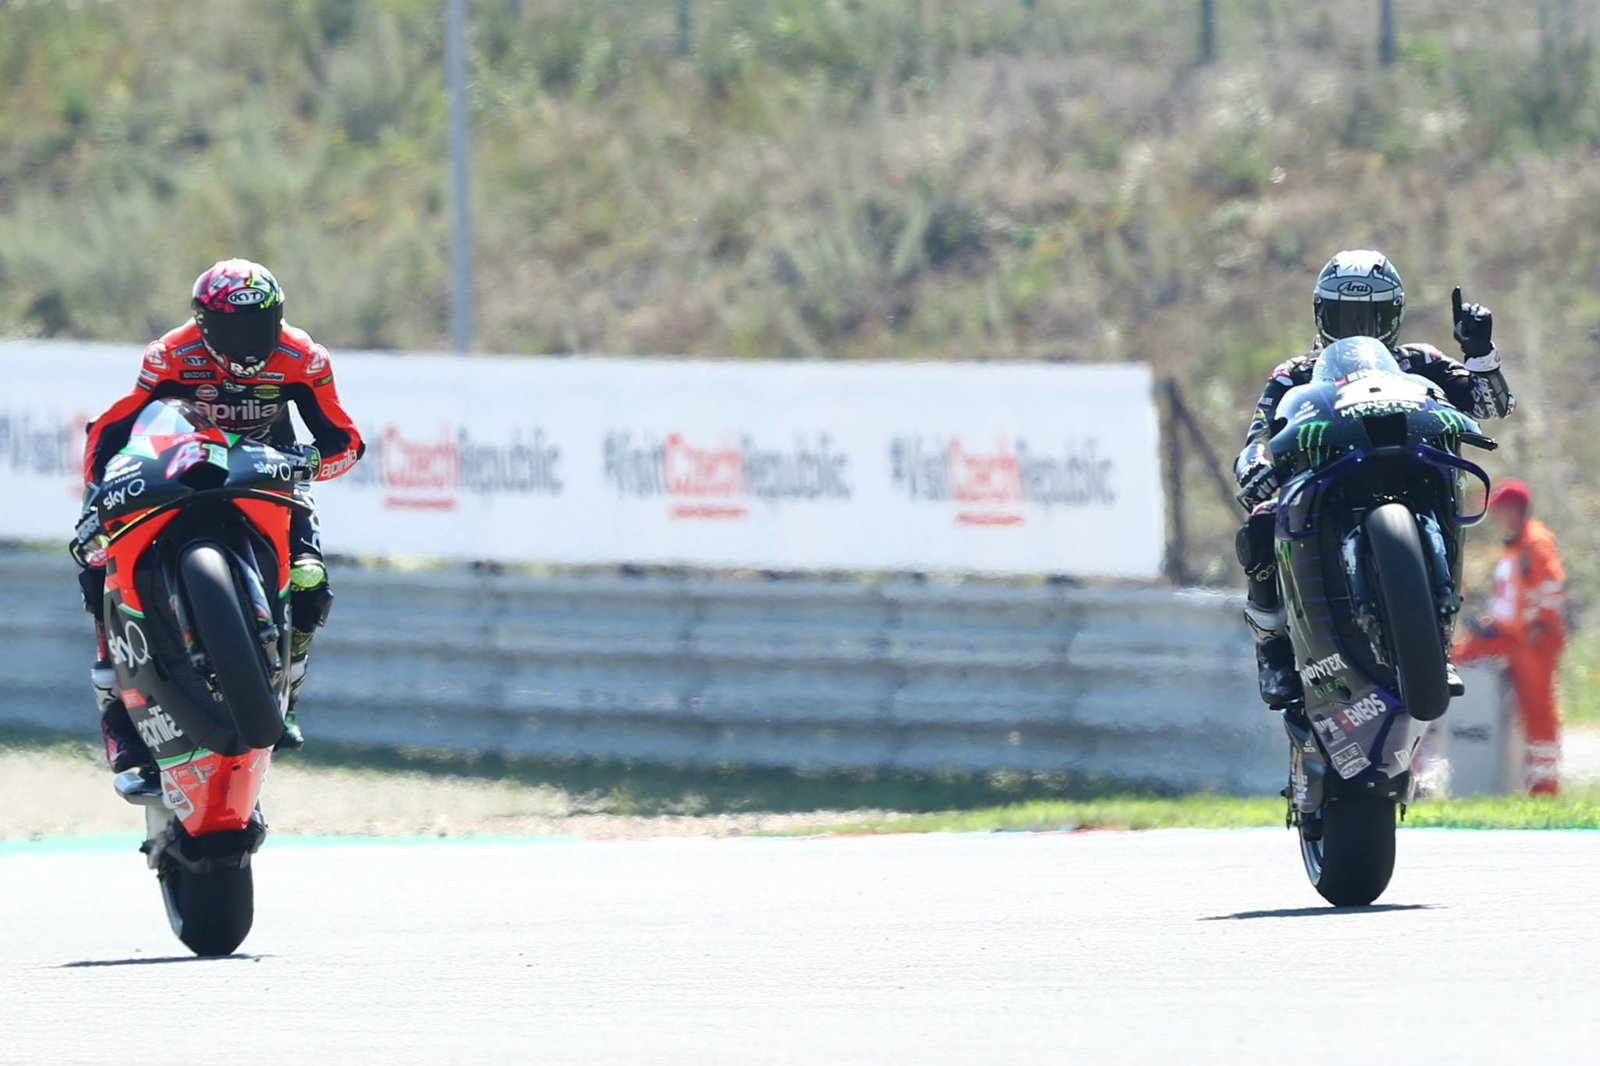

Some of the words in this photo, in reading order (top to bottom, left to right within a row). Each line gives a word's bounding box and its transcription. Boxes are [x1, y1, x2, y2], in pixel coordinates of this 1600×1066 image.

[230, 290, 263, 301] KYT
[1339, 282, 1369, 293] Arai
[194, 399, 278, 422] aprilia
[1340, 400, 1425, 418] MONSTER
[254, 461, 278, 478] sky
[321, 449, 358, 478] aprilia
[103, 487, 126, 511] sky
[127, 479, 146, 496] Q
[125, 620, 152, 664] Q
[1343, 692, 1387, 727] ENEOS
[138, 705, 184, 752] aprilia
[1334, 746, 1360, 765] BLUE
